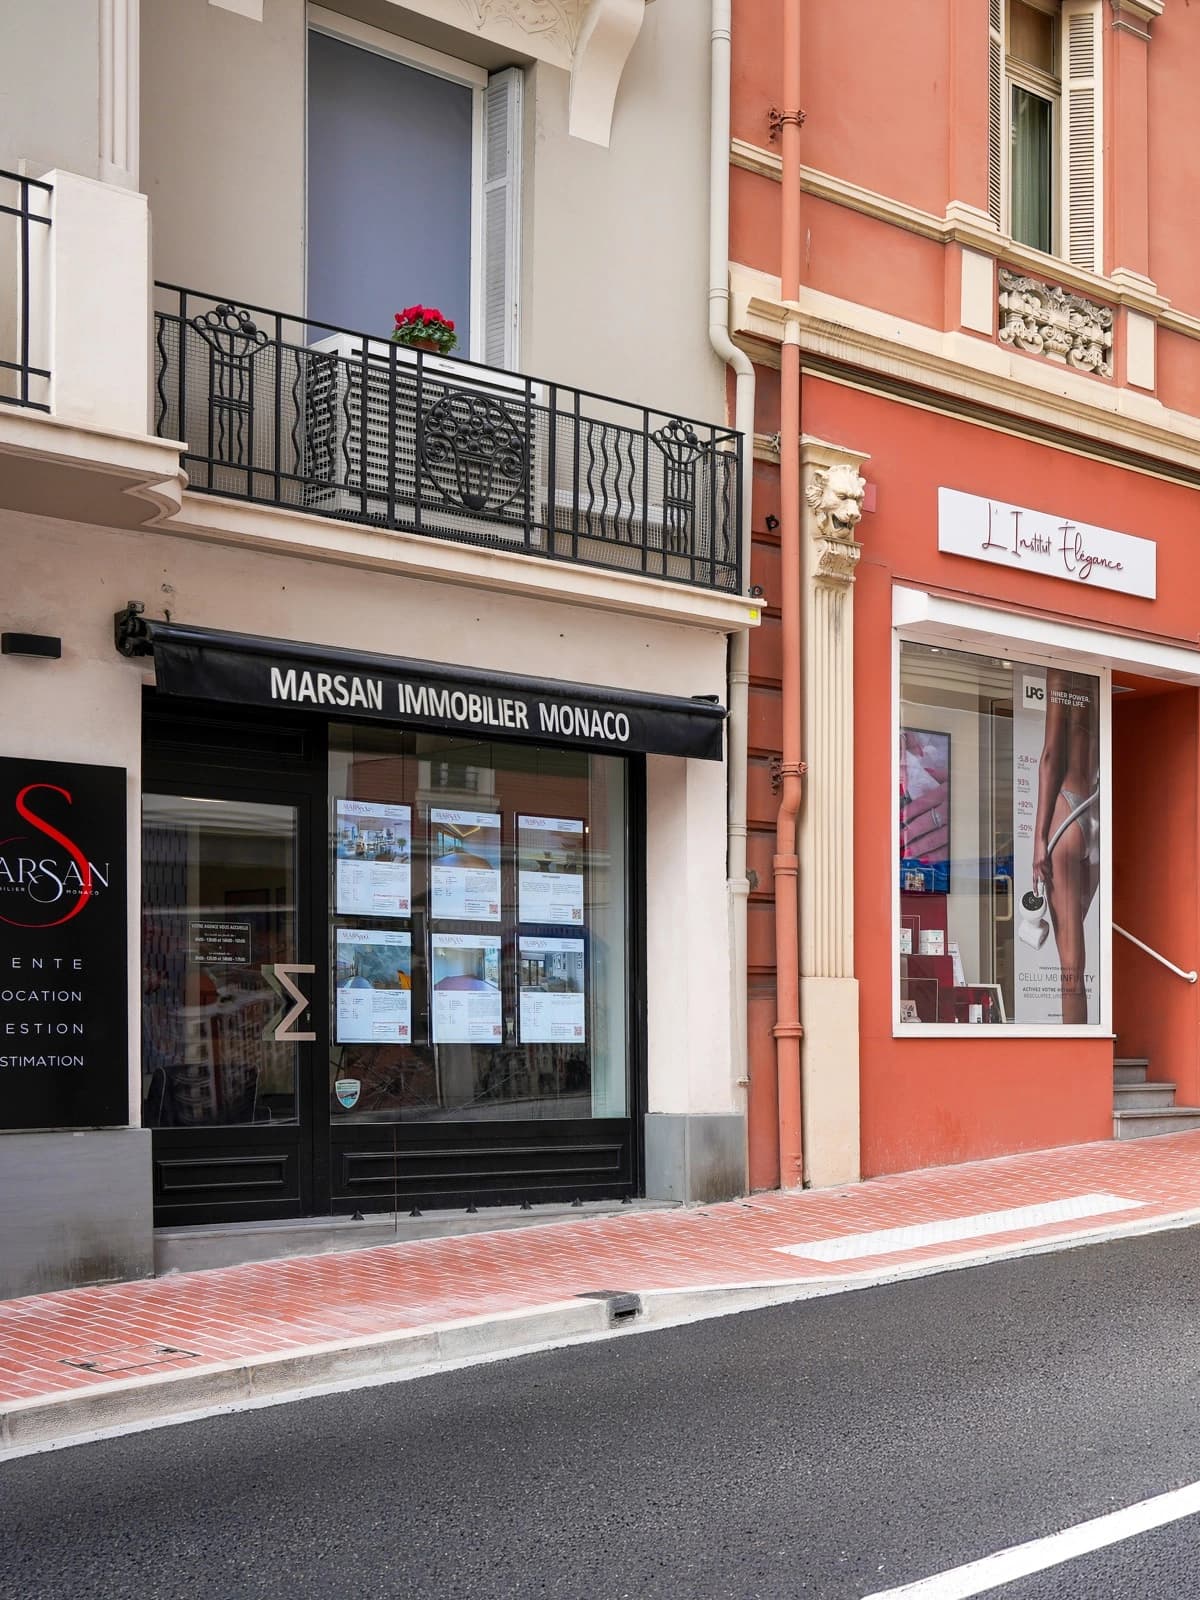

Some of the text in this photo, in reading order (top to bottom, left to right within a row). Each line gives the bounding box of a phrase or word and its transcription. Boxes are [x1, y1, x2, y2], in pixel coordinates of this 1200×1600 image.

[1025, 686, 1044, 700] LPG
[1050, 690, 1068, 698] INNER
[270, 667, 630, 742] MARSAN IMMOBILIER MONACO
[1050, 697, 1072, 705] BETTER
[1, 990, 82, 1002] OCATION
[5, 1023, 84, 1035] ESTION
[0, 1055, 84, 1067] STIMATION
